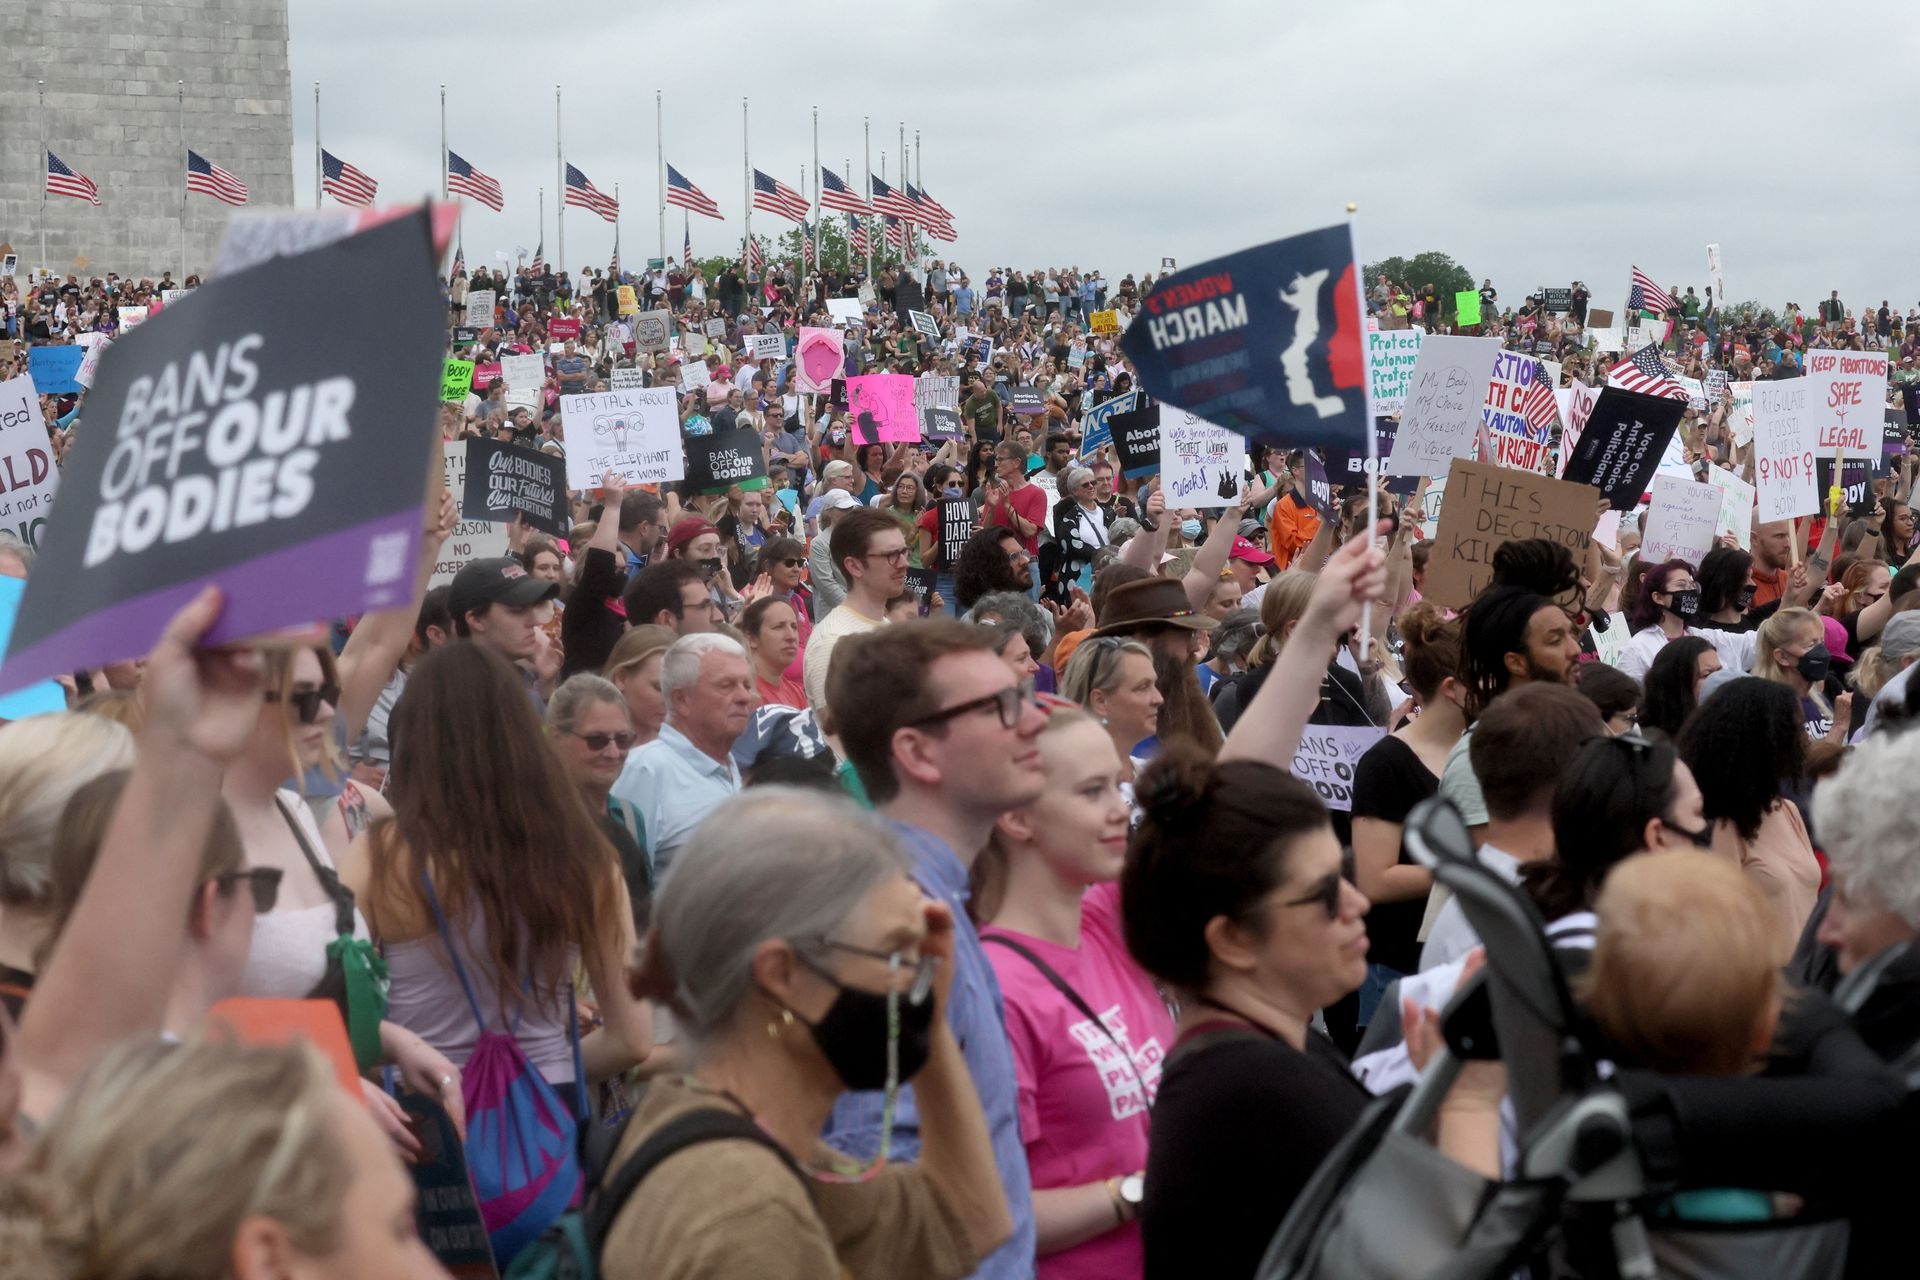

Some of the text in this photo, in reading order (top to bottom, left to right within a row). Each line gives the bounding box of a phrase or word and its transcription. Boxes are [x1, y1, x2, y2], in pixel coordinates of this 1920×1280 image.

[608, 329, 620, 338] NO
[641, 321, 659, 329] STOP
[757, 338, 779, 346] 1973
[1369, 333, 1421, 350] Protect
[447, 364, 470, 377] BODY
[1811, 355, 1886, 376] KEEP ABORTIONS
[116, 334, 264, 440] BANS
[440, 385, 468, 397] CHOICE
[1420, 369, 1467, 399] My Body
[565, 392, 671, 414] LET'S TALK ABOUT
[1485, 381, 1508, 408] TH
[1574, 389, 1592, 416] NO
[1762, 390, 1807, 414] REGULATE
[1827, 381, 1862, 408] SAFE
[1415, 395, 1463, 415] My Choice
[1408, 417, 1419, 435] My
[1768, 417, 1801, 439] FOSSIL
[1885, 429, 1902, 438] Care.
[100, 377, 356, 501] OFF OUR
[1772, 437, 1801, 456] FUELS
[1819, 426, 1867, 449] LEGAL
[709, 448, 739, 461] BANS
[1408, 440, 1420, 457] My
[1591, 422, 1628, 485] Politicians
[1604, 420, 1644, 492] Anti-Choice
[1622, 432, 1655, 485] Vote Out
[489, 451, 551, 486] Our BODIES
[587, 450, 671, 471] THE ELEPHANT
[710, 456, 754, 470] OFF OUR
[1774, 456, 1799, 479] NOT
[590, 474, 604, 485] IN
[637, 468, 667, 480] WOMB
[712, 466, 752, 480] BODIES
[489, 474, 555, 503] OUR Futures
[1311, 480, 1331, 505] BODY
[1459, 471, 1542, 514] THIS
[1663, 482, 1715, 499] IF YOU'RE
[1780, 481, 1792, 494] MY
[18, 493, 38, 514] not
[83, 448, 321, 568] BODIES
[486, 489, 553, 519] Our ABORTIONS
[945, 501, 969, 522] HOW
[1662, 503, 1695, 512] against
[1774, 496, 1797, 516] BODY
[946, 521, 972, 541] DARE
[1477, 509, 1590, 550] DECISION
[1664, 520, 1694, 532] GET
[1671, 532, 1678, 540] A
[453, 543, 471, 556] NO
[1646, 540, 1709, 560] VASECTOMY
[433, 561, 469, 575] XCEP
[914, 586, 928, 594] OUR
[1293, 756, 1331, 778] OFF
